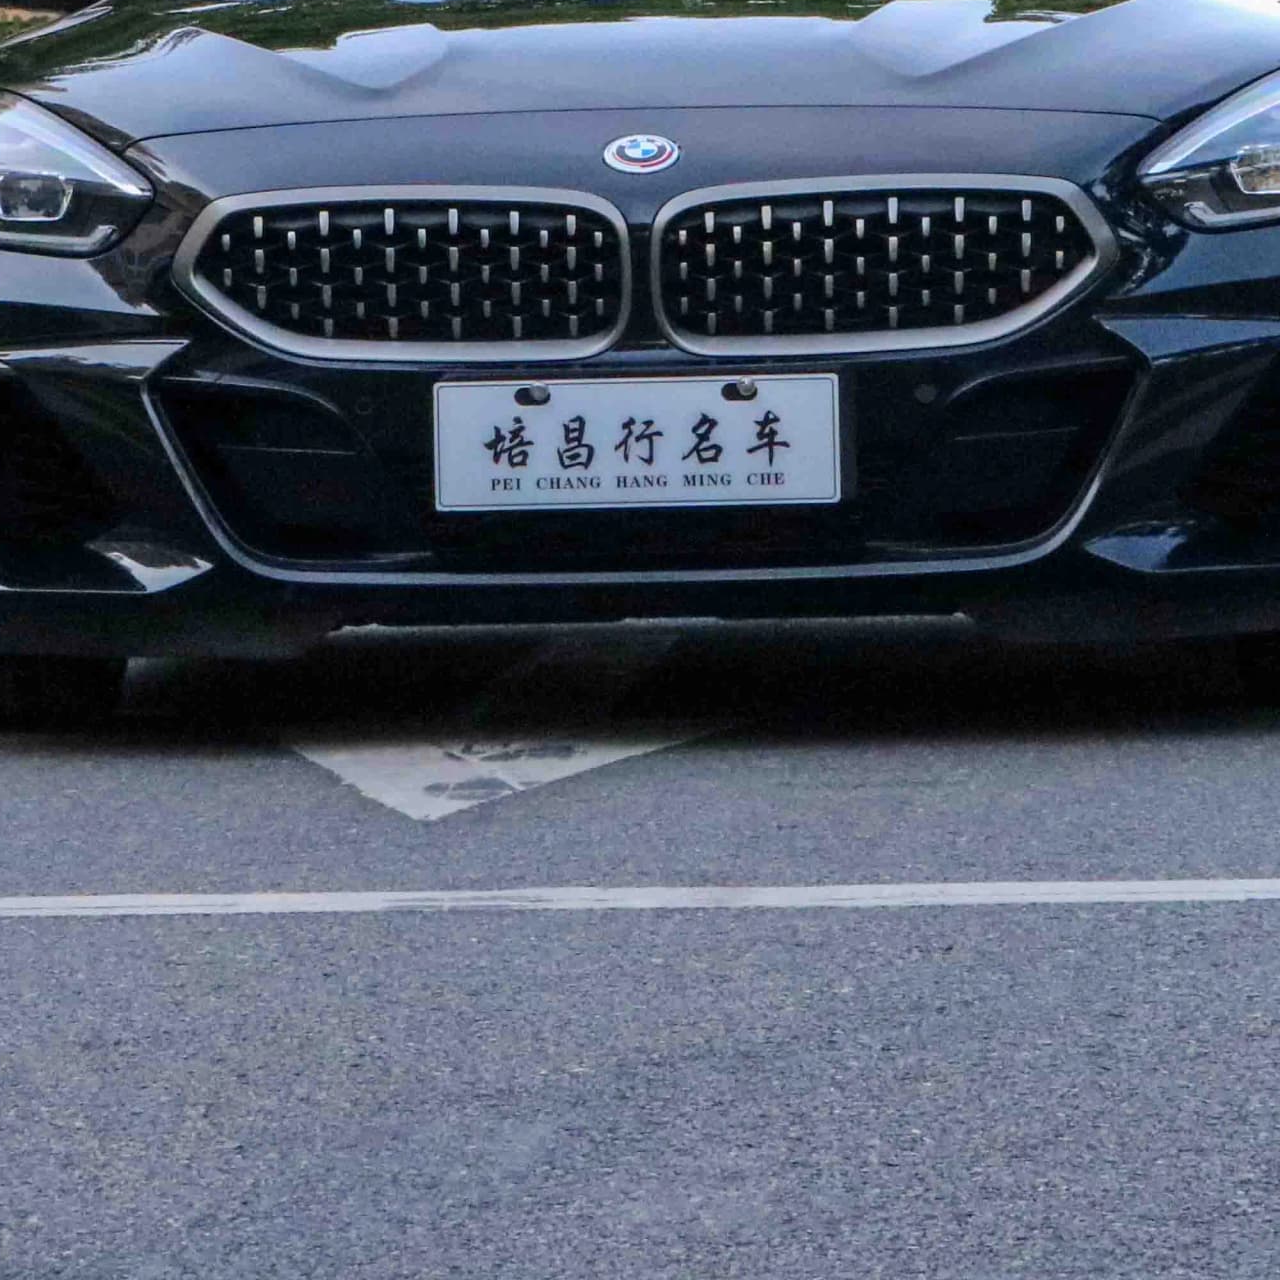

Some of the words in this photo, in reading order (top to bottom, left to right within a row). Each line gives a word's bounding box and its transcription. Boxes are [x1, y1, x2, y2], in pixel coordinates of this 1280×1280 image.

[483, 410, 791, 470] 培昌行名车
[490, 477, 521, 492] PEI
[535, 476, 601, 490] CHANG
[616, 474, 668, 489] HANG
[683, 473, 732, 487] MING
[746, 472, 785, 486] CHE
